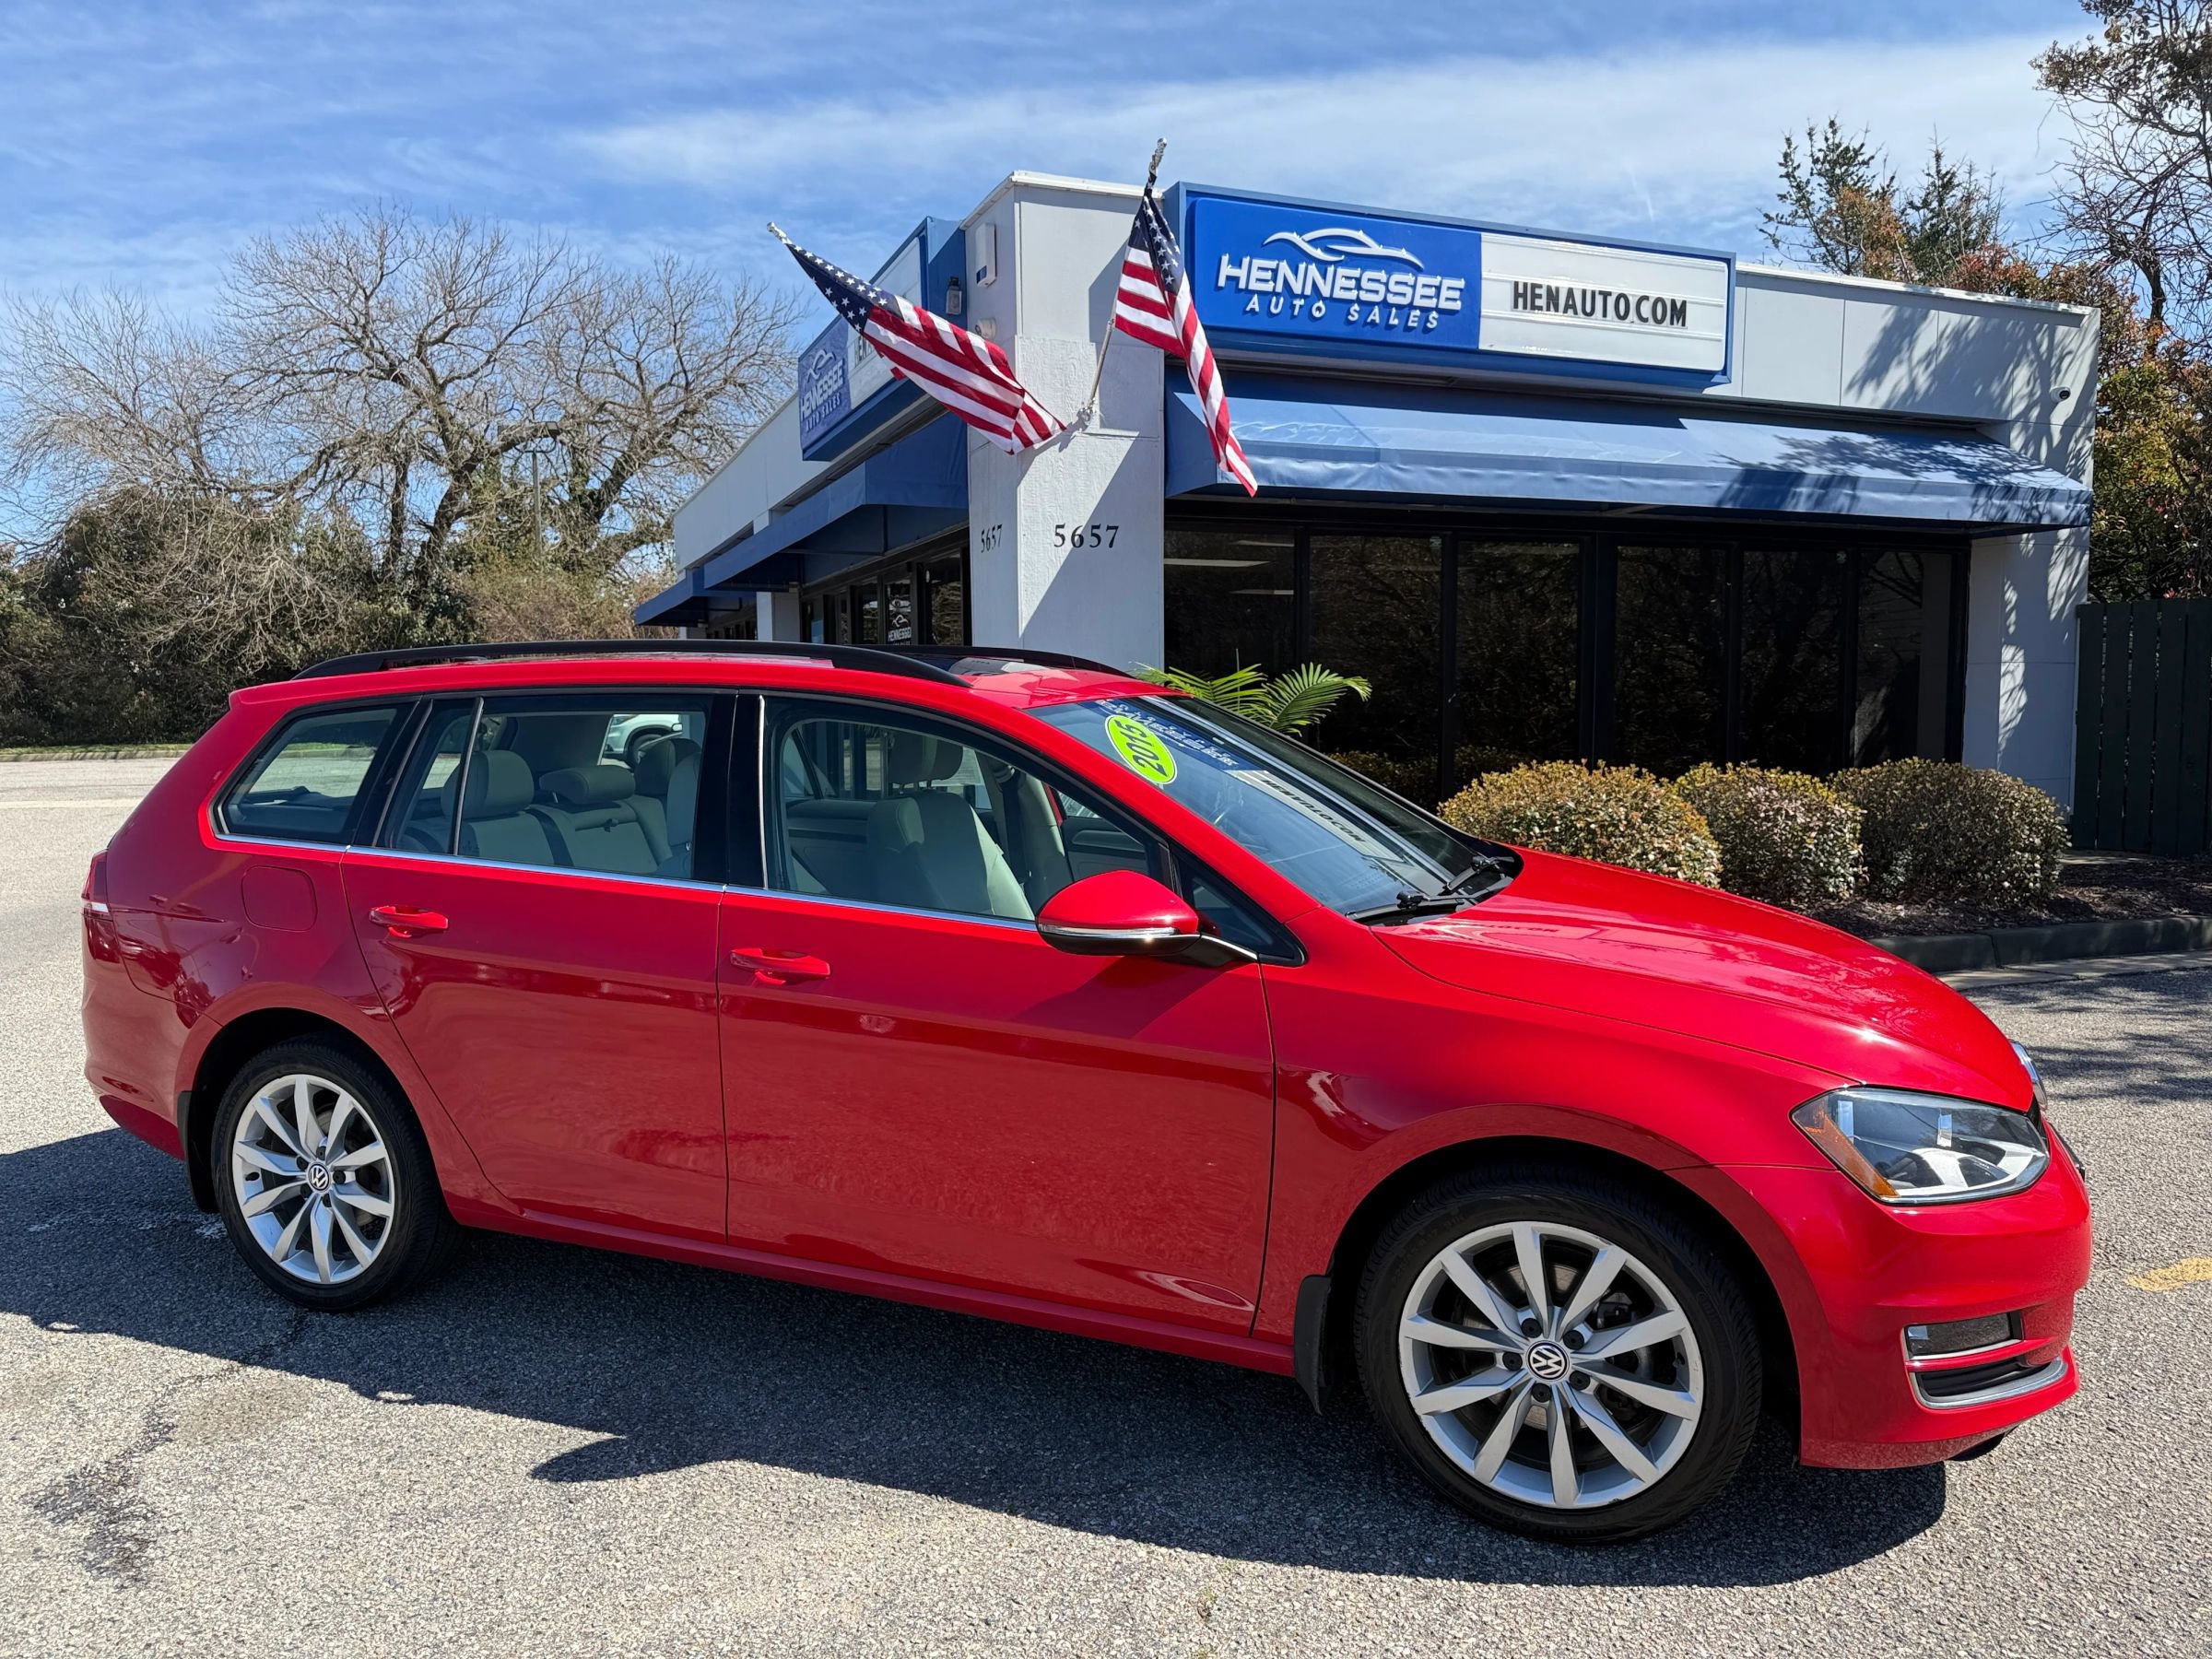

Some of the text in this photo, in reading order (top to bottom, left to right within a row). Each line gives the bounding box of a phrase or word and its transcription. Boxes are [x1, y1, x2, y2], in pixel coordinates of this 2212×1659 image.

[1217, 253, 1465, 312] HENNESSEE
[1245, 293, 1440, 329] AUTO SALES
[1512, 280, 1688, 328] HENAUTO.COM
[980, 524, 1003, 554] 5657
[1053, 523, 1120, 549] 5657
[1113, 719, 1170, 778] 2015
